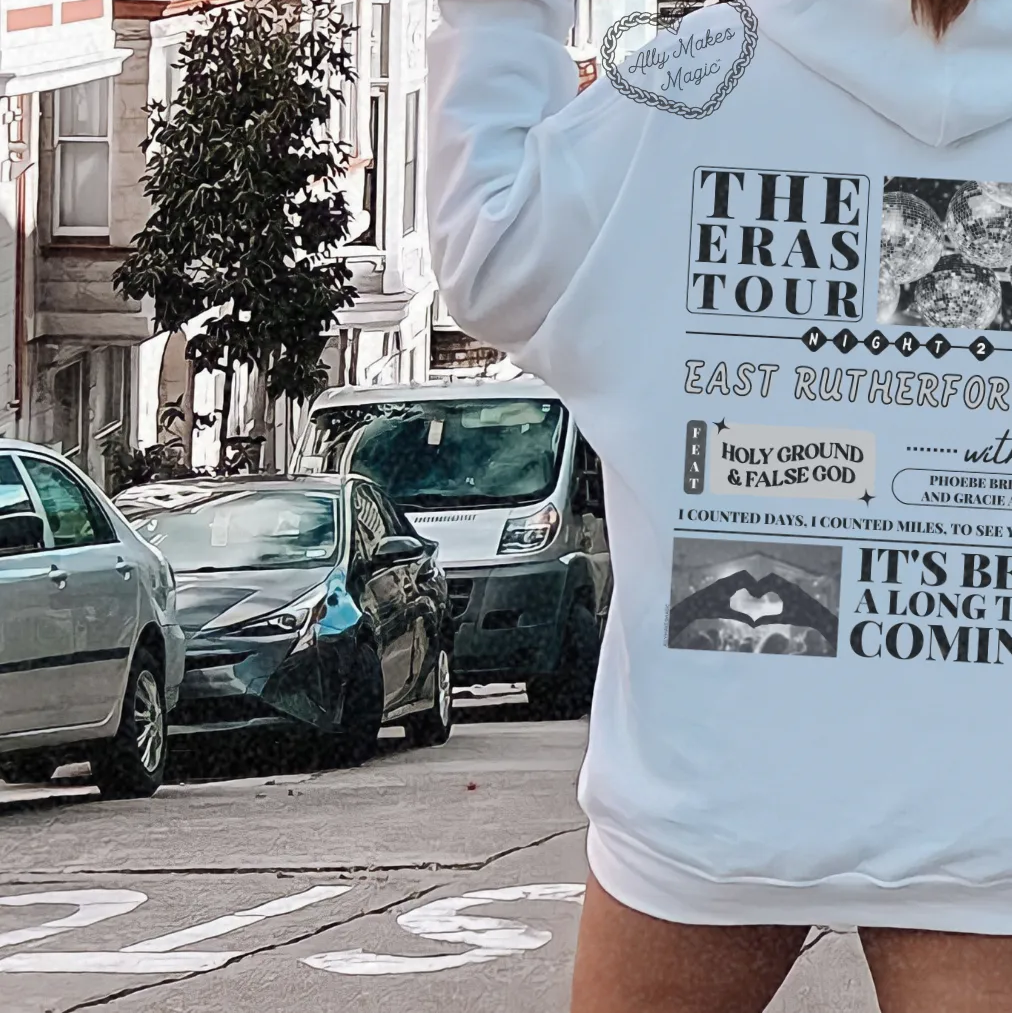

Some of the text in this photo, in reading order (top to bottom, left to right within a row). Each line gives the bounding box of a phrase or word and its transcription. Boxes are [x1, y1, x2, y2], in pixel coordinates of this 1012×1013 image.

[700, 170, 861, 226] THE
[694, 223, 860, 271] ERAS
[692, 273, 860, 319] TOUR
[808, 332, 944, 354] NIGHT
[684, 359, 780, 398] EAST
[721, 441, 864, 465] HOLY GROUND
[727, 465, 856, 488] & FALSE GOD
[929, 475, 987, 489] PHOEBE
[921, 491, 950, 503] AND
[953, 492, 1005, 506] GRACIE
[678, 508, 684, 520] I
[687, 509, 761, 524] COUNTED
[811, 515, 817, 527] I
[819, 516, 894, 532] COUNTED
[951, 523, 973, 537] TO
[975, 524, 1003, 538] SEE
[857, 547, 948, 587] IT'S
[854, 588, 879, 614] A
[887, 590, 987, 620] LONG
